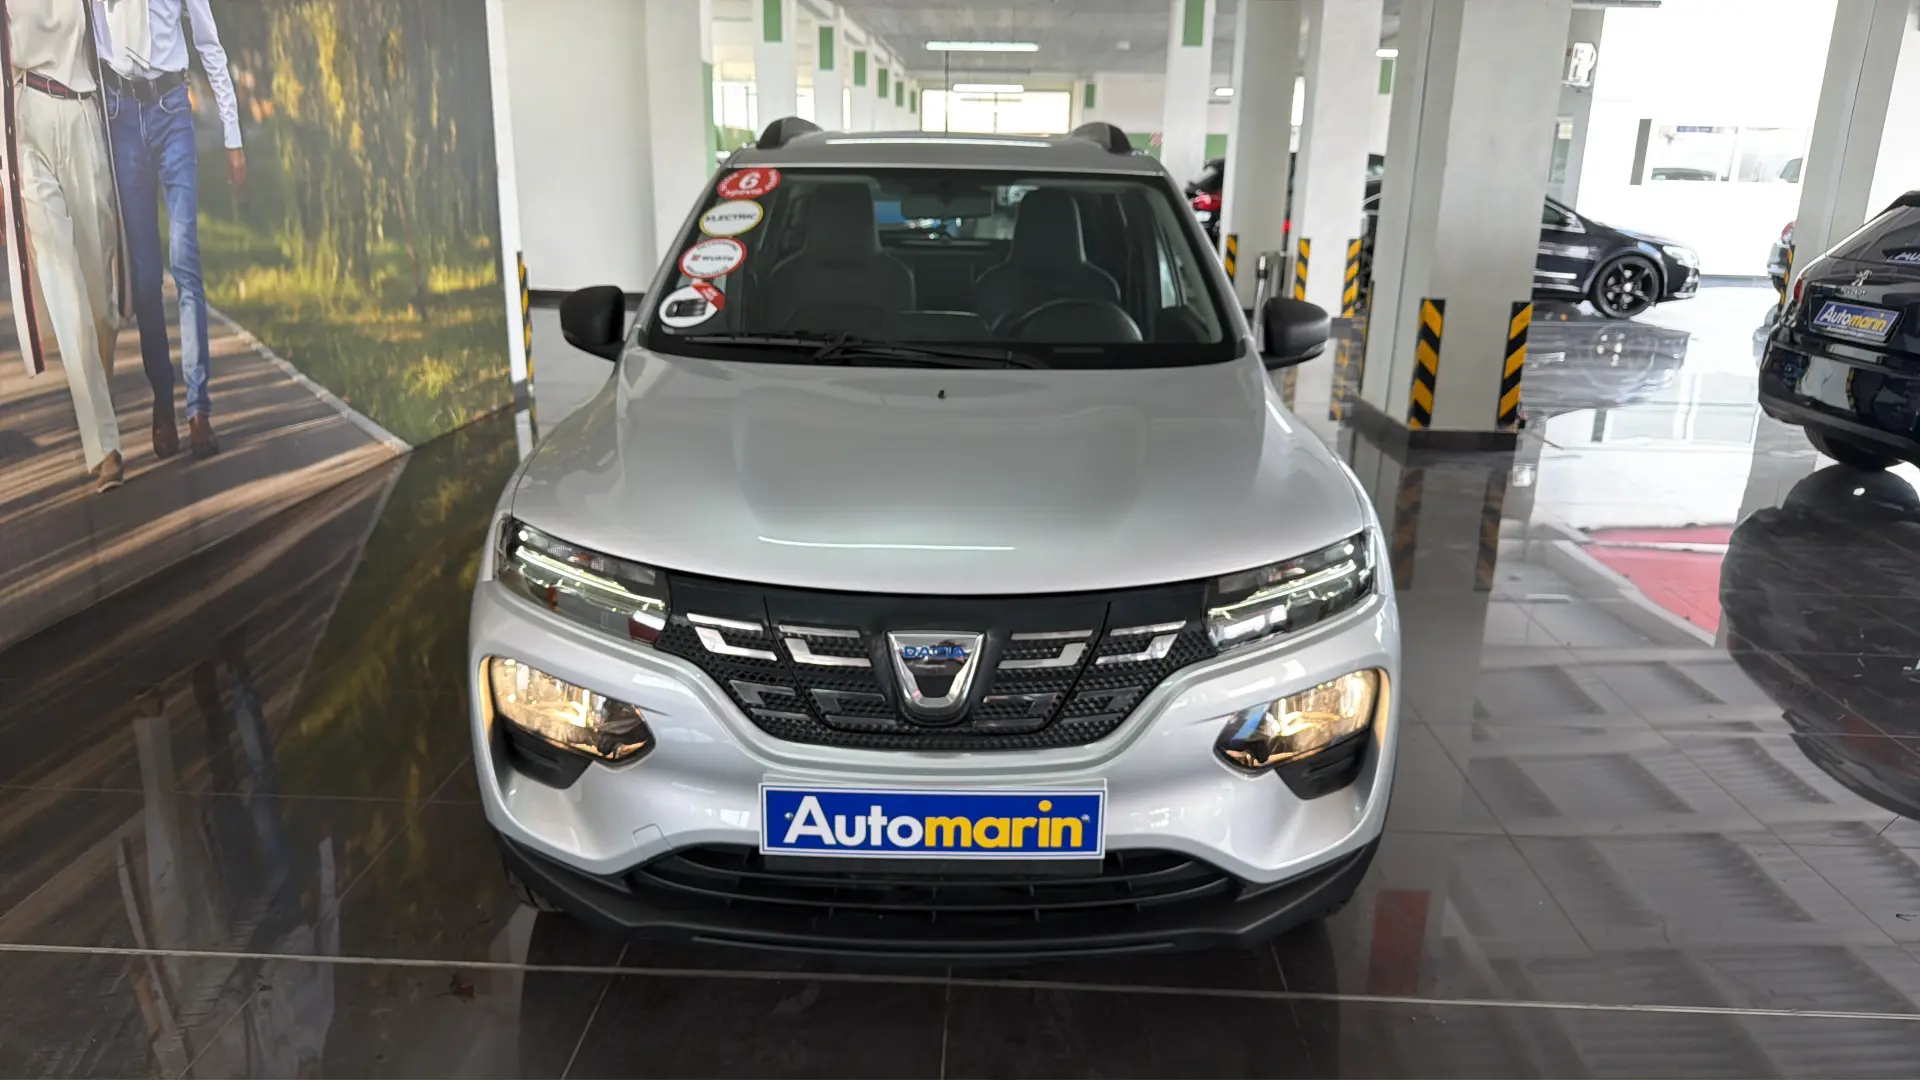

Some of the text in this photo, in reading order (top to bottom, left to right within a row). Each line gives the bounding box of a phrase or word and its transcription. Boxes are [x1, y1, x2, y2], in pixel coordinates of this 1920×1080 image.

[739, 171, 761, 190] 6
[1820, 304, 1887, 332] Automarin
[903, 645, 965, 658] DACIA
[783, 796, 1083, 849] Automarin
